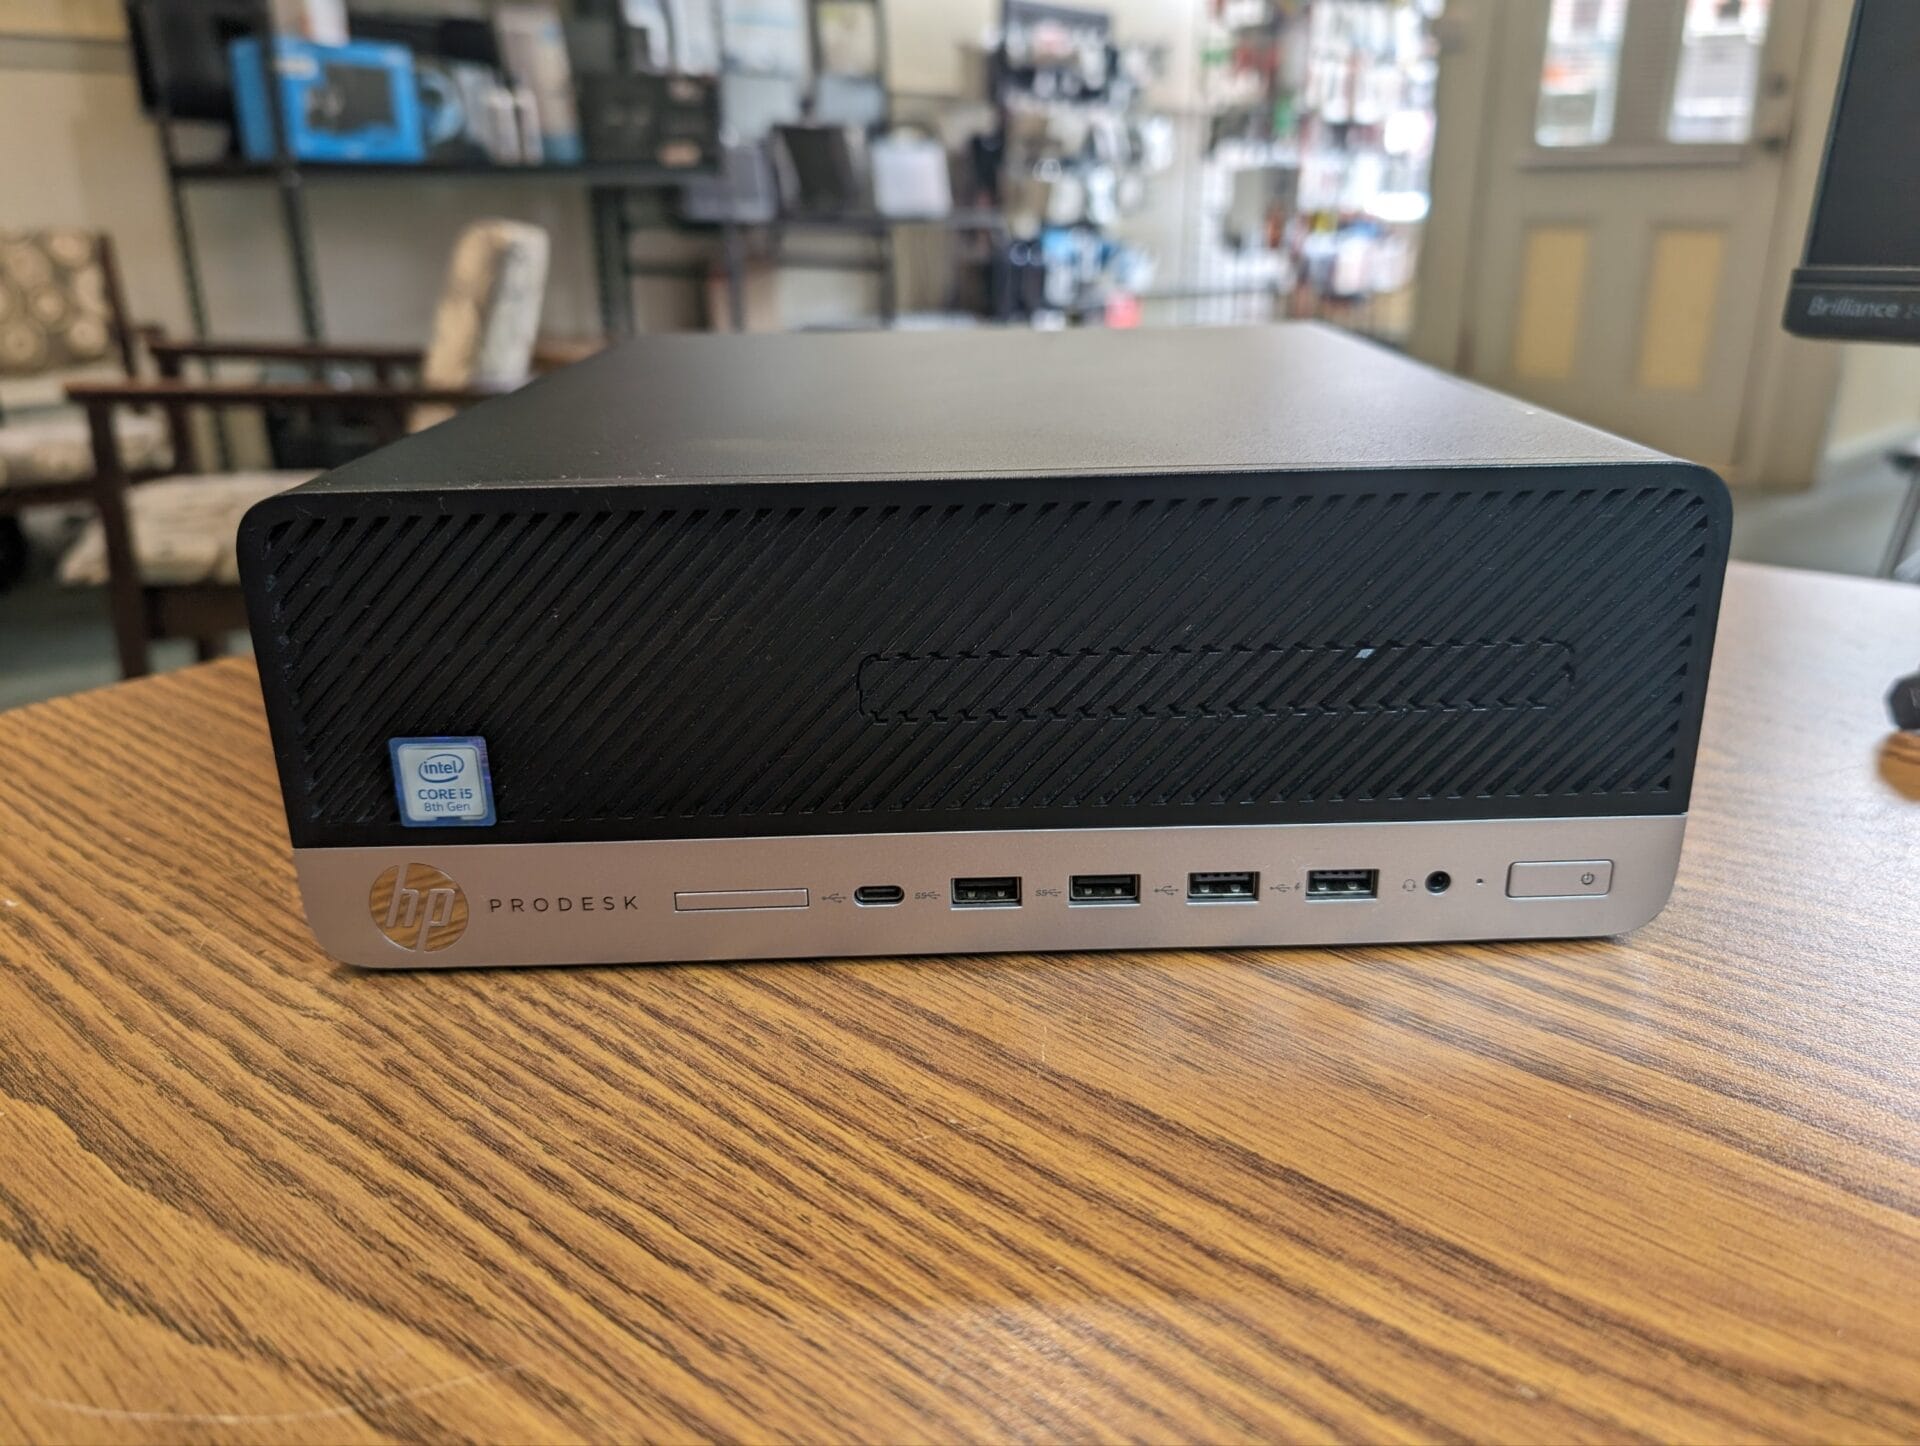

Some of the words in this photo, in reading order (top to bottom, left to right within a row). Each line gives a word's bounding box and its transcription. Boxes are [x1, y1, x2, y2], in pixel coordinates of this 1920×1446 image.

[1807, 296, 1898, 318] Brilliance
[423, 760, 458, 775] intel
[418, 788, 457, 800] CORE
[460, 788, 473, 800] i5
[424, 802, 444, 812] 8th
[447, 801, 472, 812] Gen
[384, 863, 458, 951] hp
[489, 895, 639, 913] PRODESK
